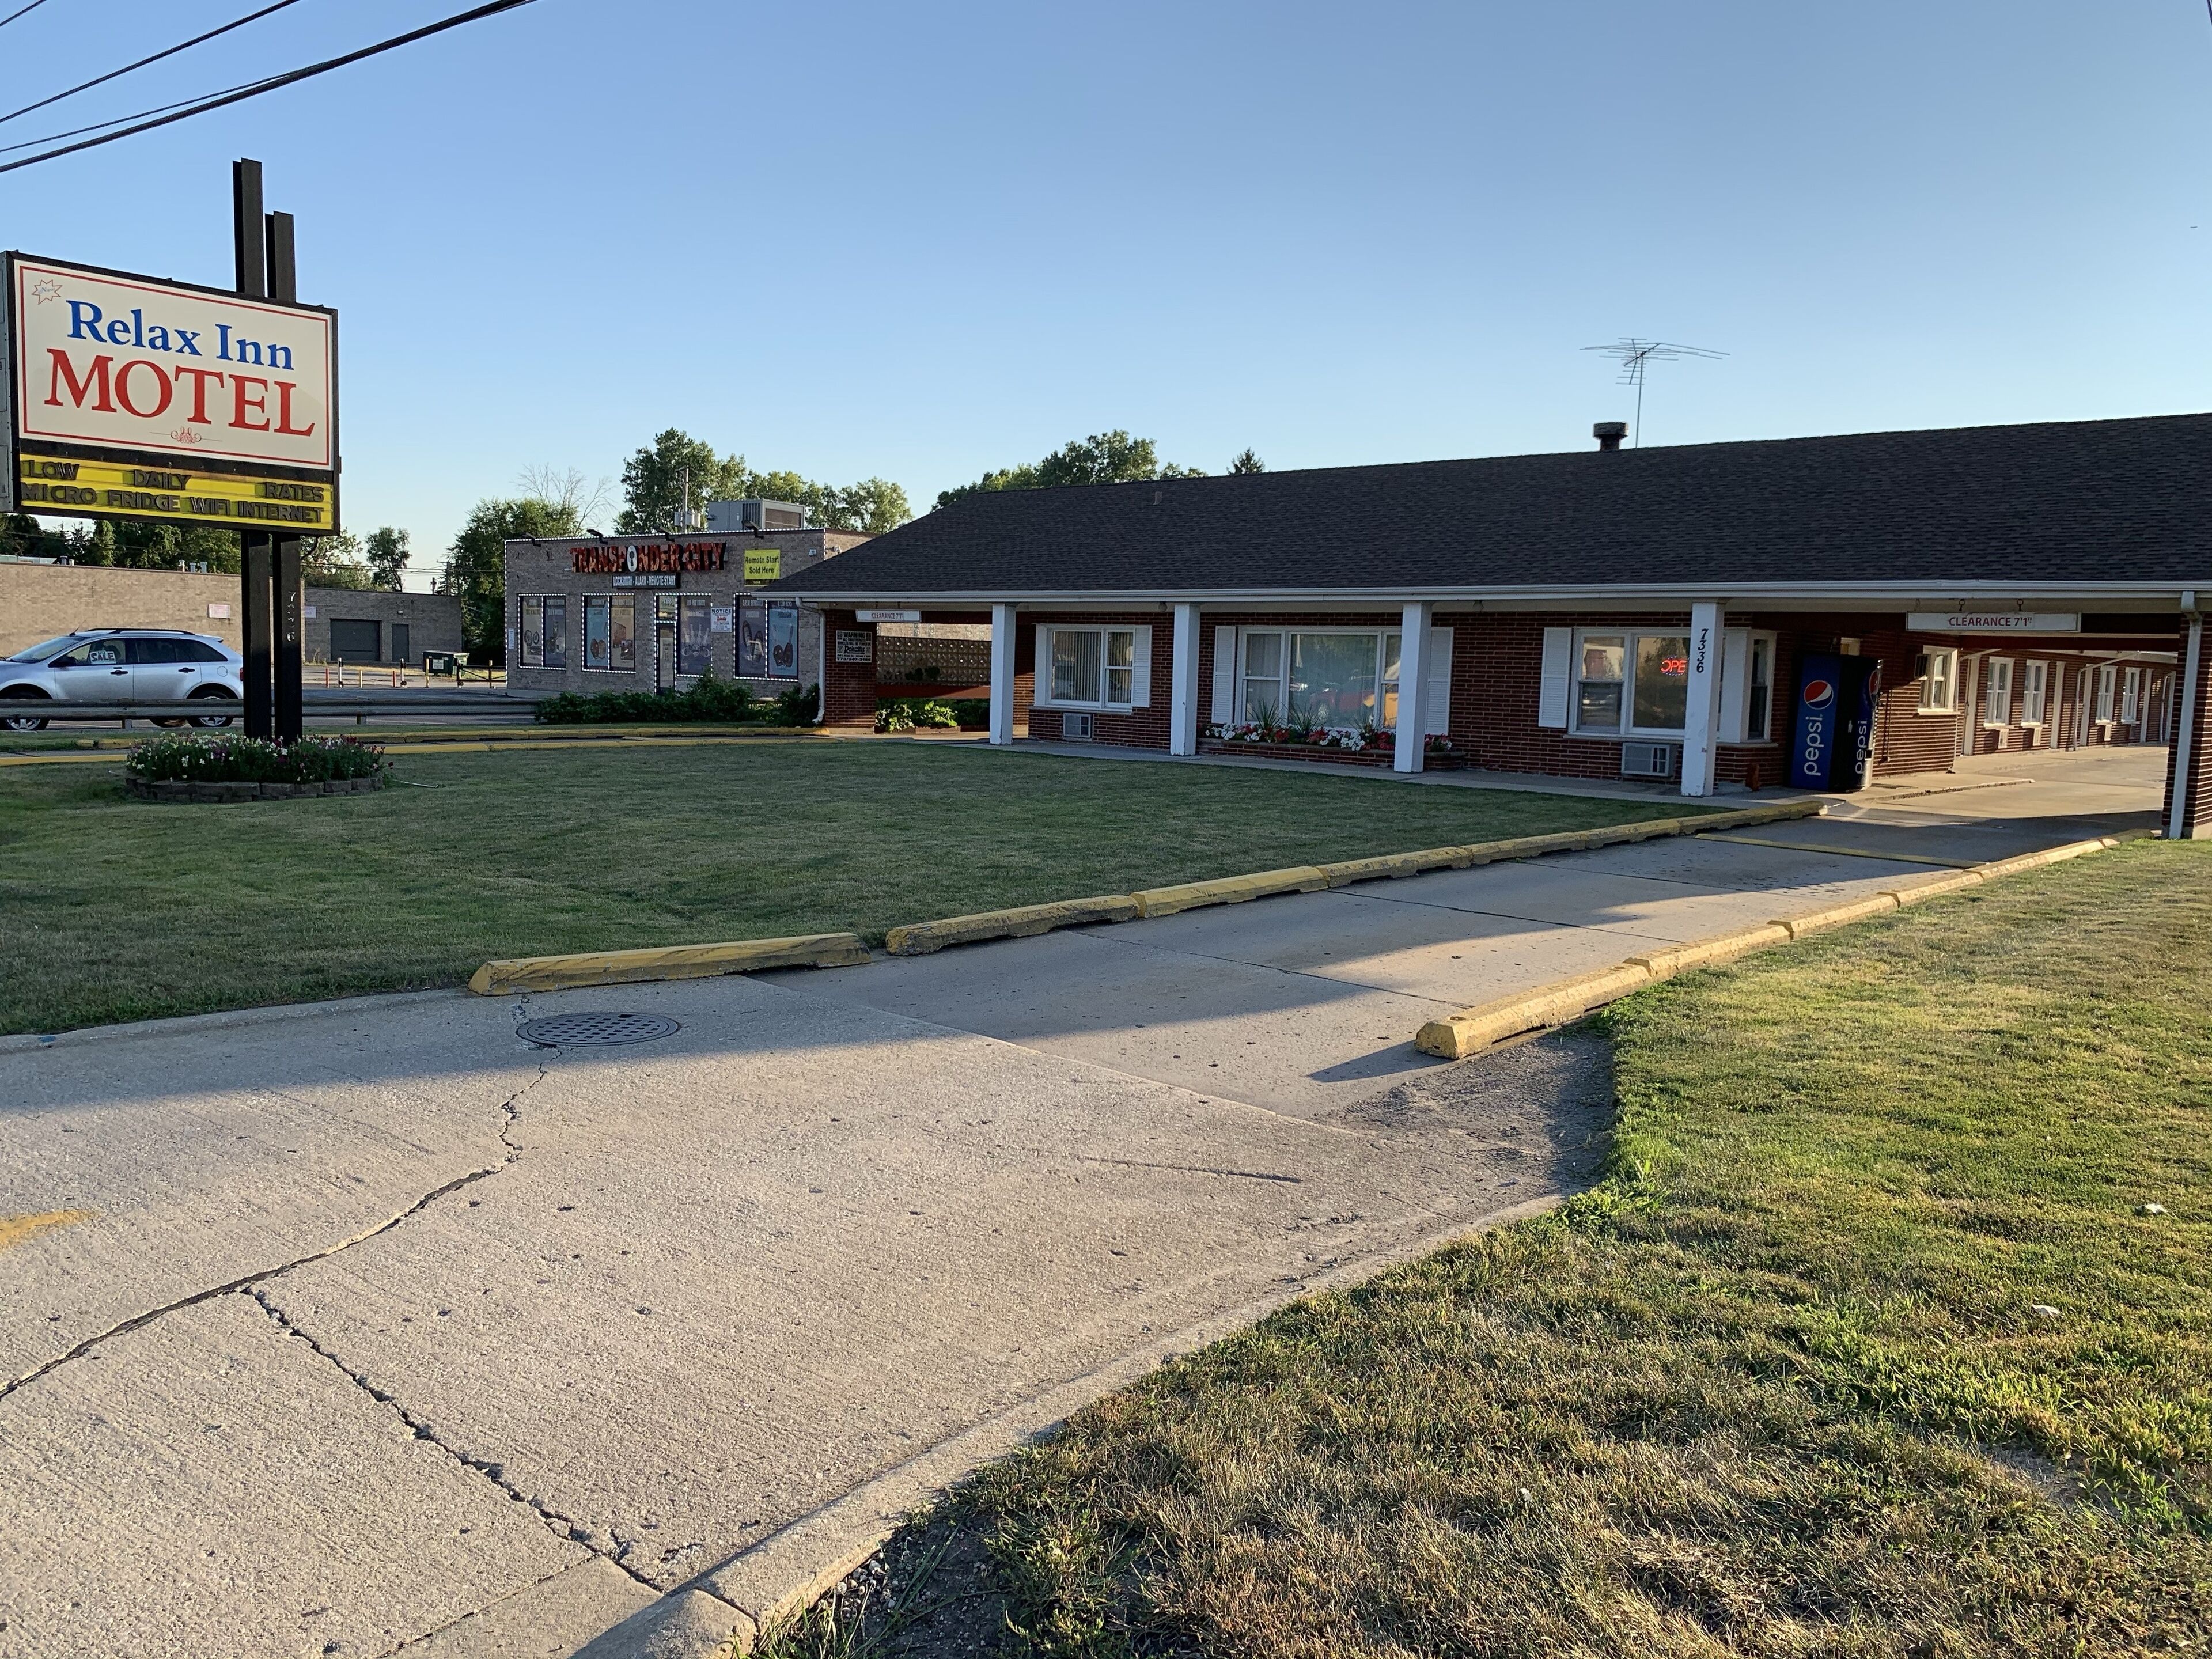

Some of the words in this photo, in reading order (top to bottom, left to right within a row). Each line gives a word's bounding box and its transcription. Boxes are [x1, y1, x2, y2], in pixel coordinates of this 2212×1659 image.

[66, 300, 203, 357] Relax
[215, 323, 295, 370] Inn
[44, 347, 316, 437] MOTEL
[29, 459, 80, 480] LOW
[134, 469, 192, 490] DAILY
[266, 482, 324, 502] RATES
[21, 482, 97, 505] MICRO
[108, 489, 181, 512] FRIDGE
[190, 497, 230, 516] WIFI
[238, 501, 324, 523] INTERNET
[569, 543, 681, 573] TRANSPONDER
[683, 541, 727, 571] CITY
[649, 575, 664, 586] REMOTE
[664, 575, 676, 586] START
[1949, 616, 2011, 627] CLEARANCE
[91, 652, 115, 661] SALE
[1660, 660, 1687, 673] OPE
[1696, 628, 1709, 673] 7336
[1804, 715, 1824, 777] pepsi
[1855, 721, 1868, 774] pepsi
